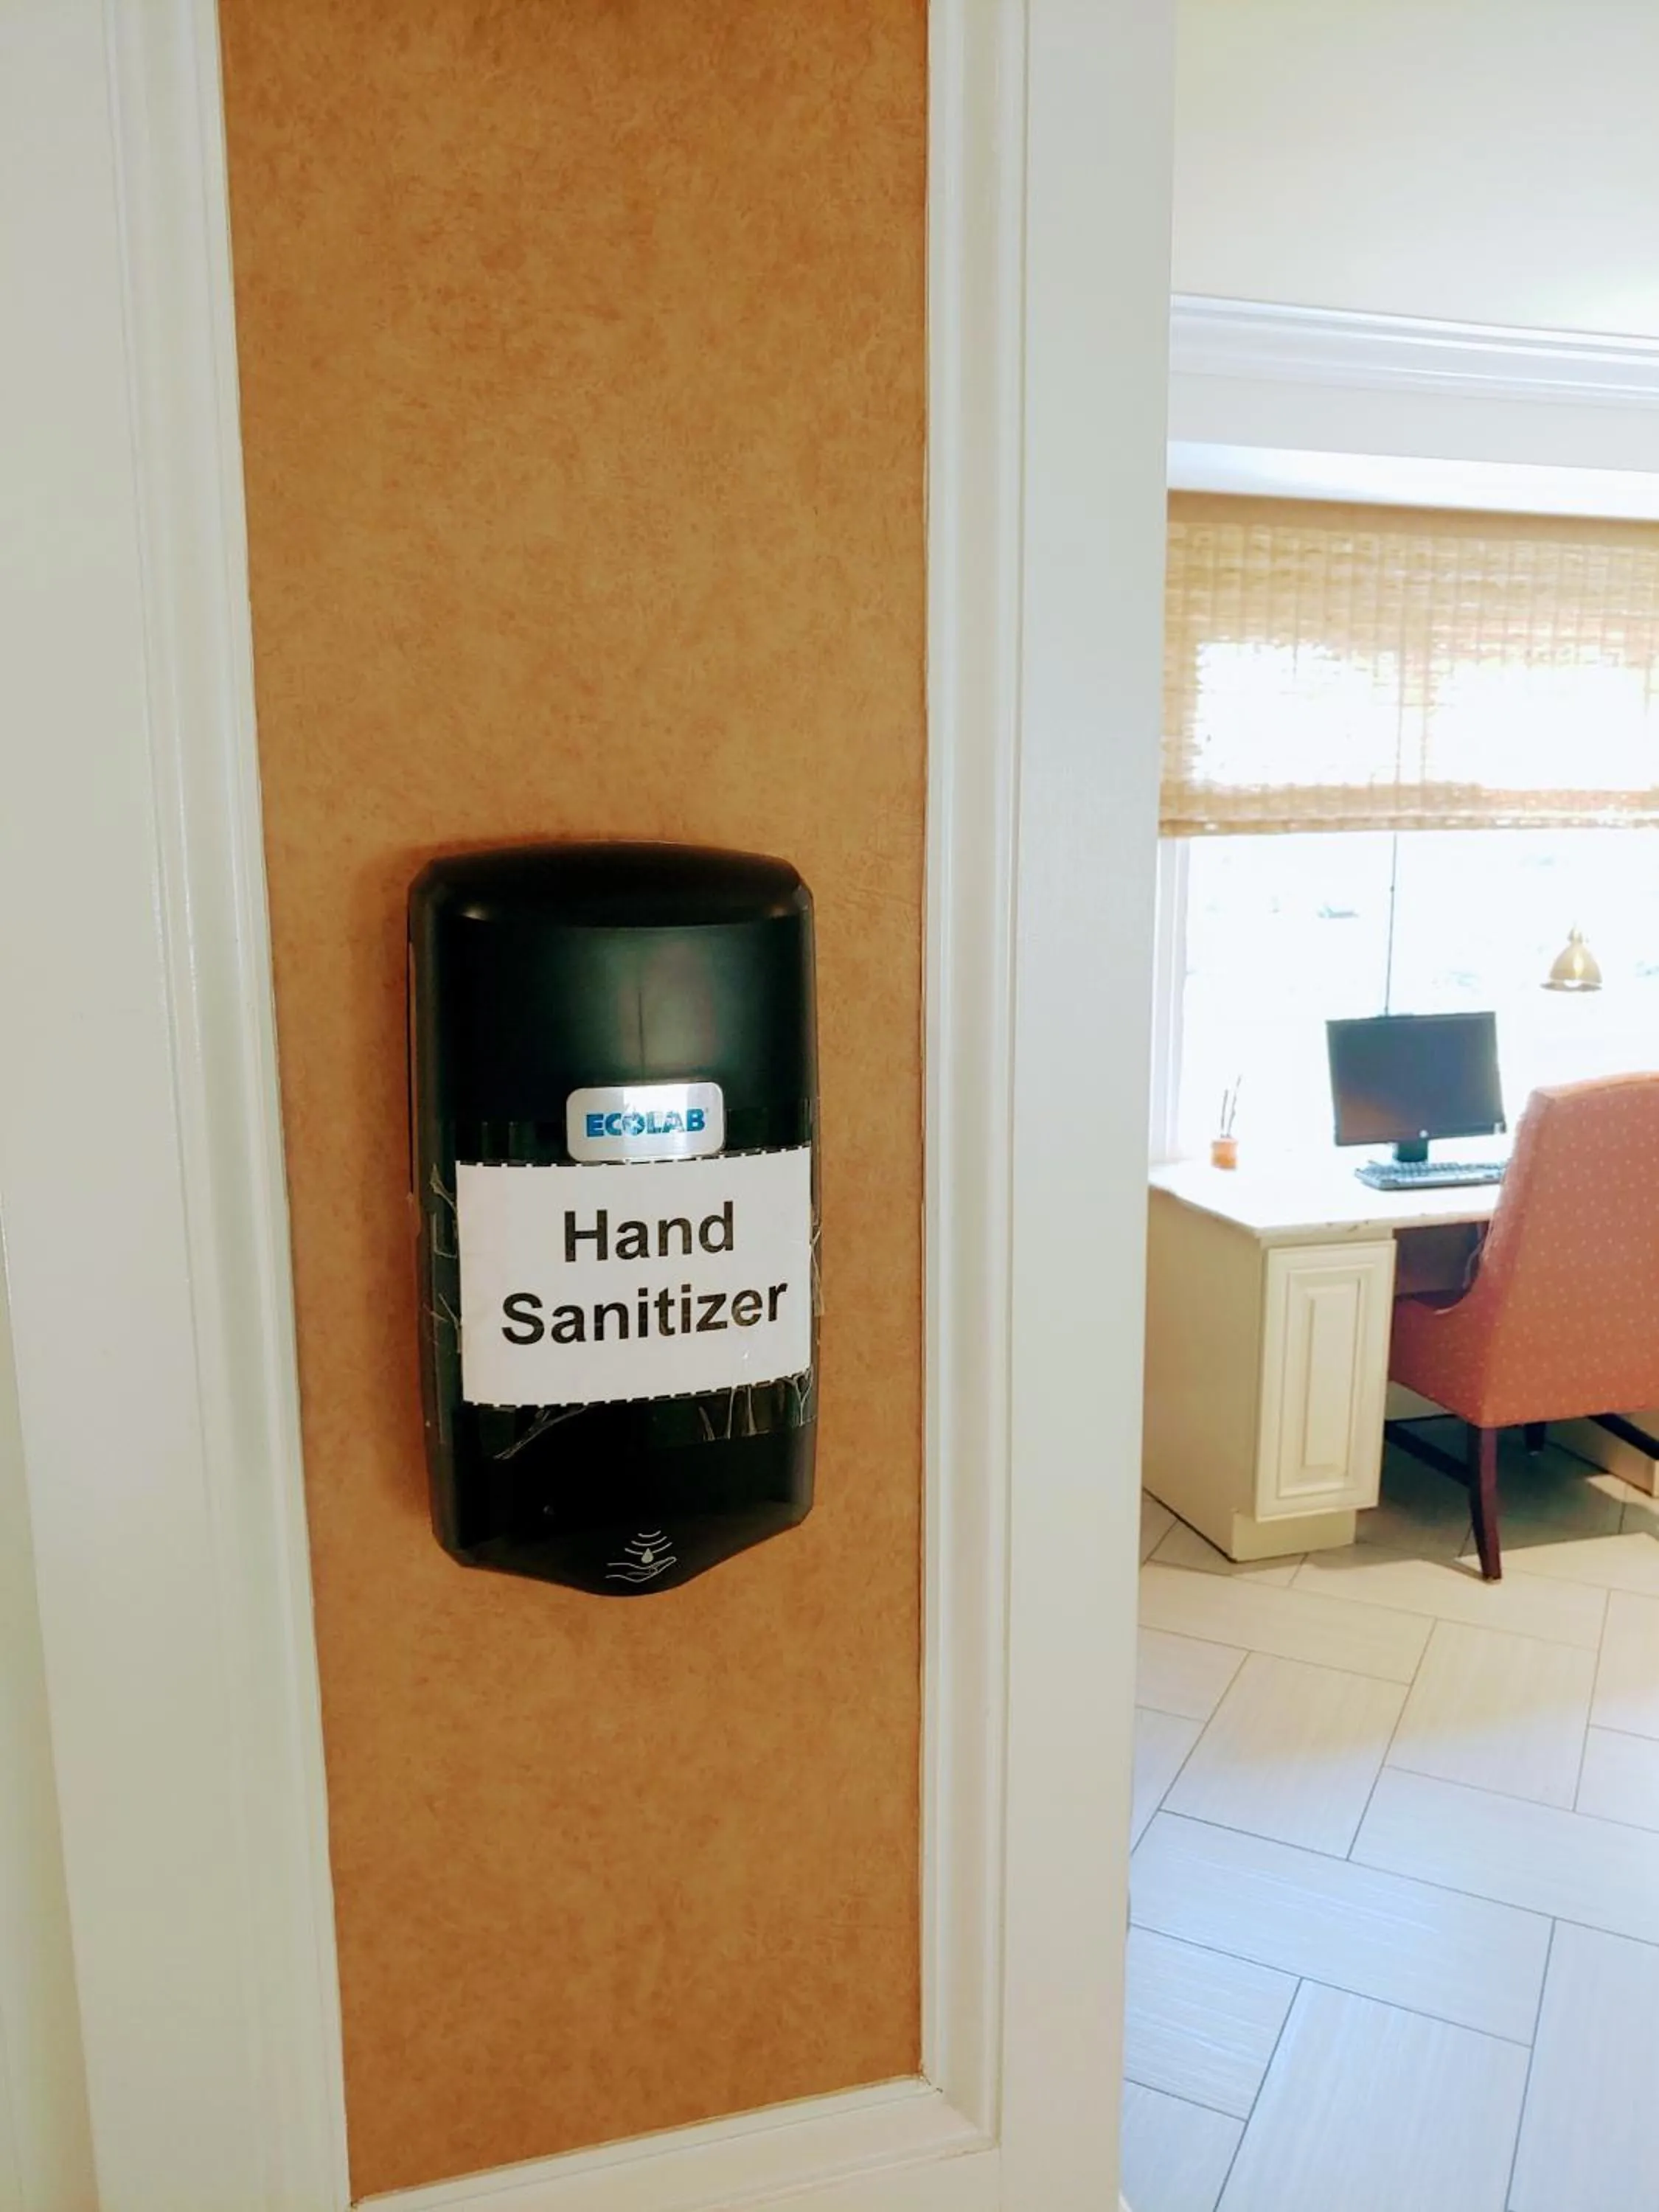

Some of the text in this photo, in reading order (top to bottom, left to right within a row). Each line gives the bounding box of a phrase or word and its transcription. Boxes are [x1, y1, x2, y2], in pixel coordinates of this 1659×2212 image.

[585, 1108, 706, 1137] ECOLAB
[564, 1201, 734, 1262] Hand
[501, 1282, 788, 1345] Sanitizer
